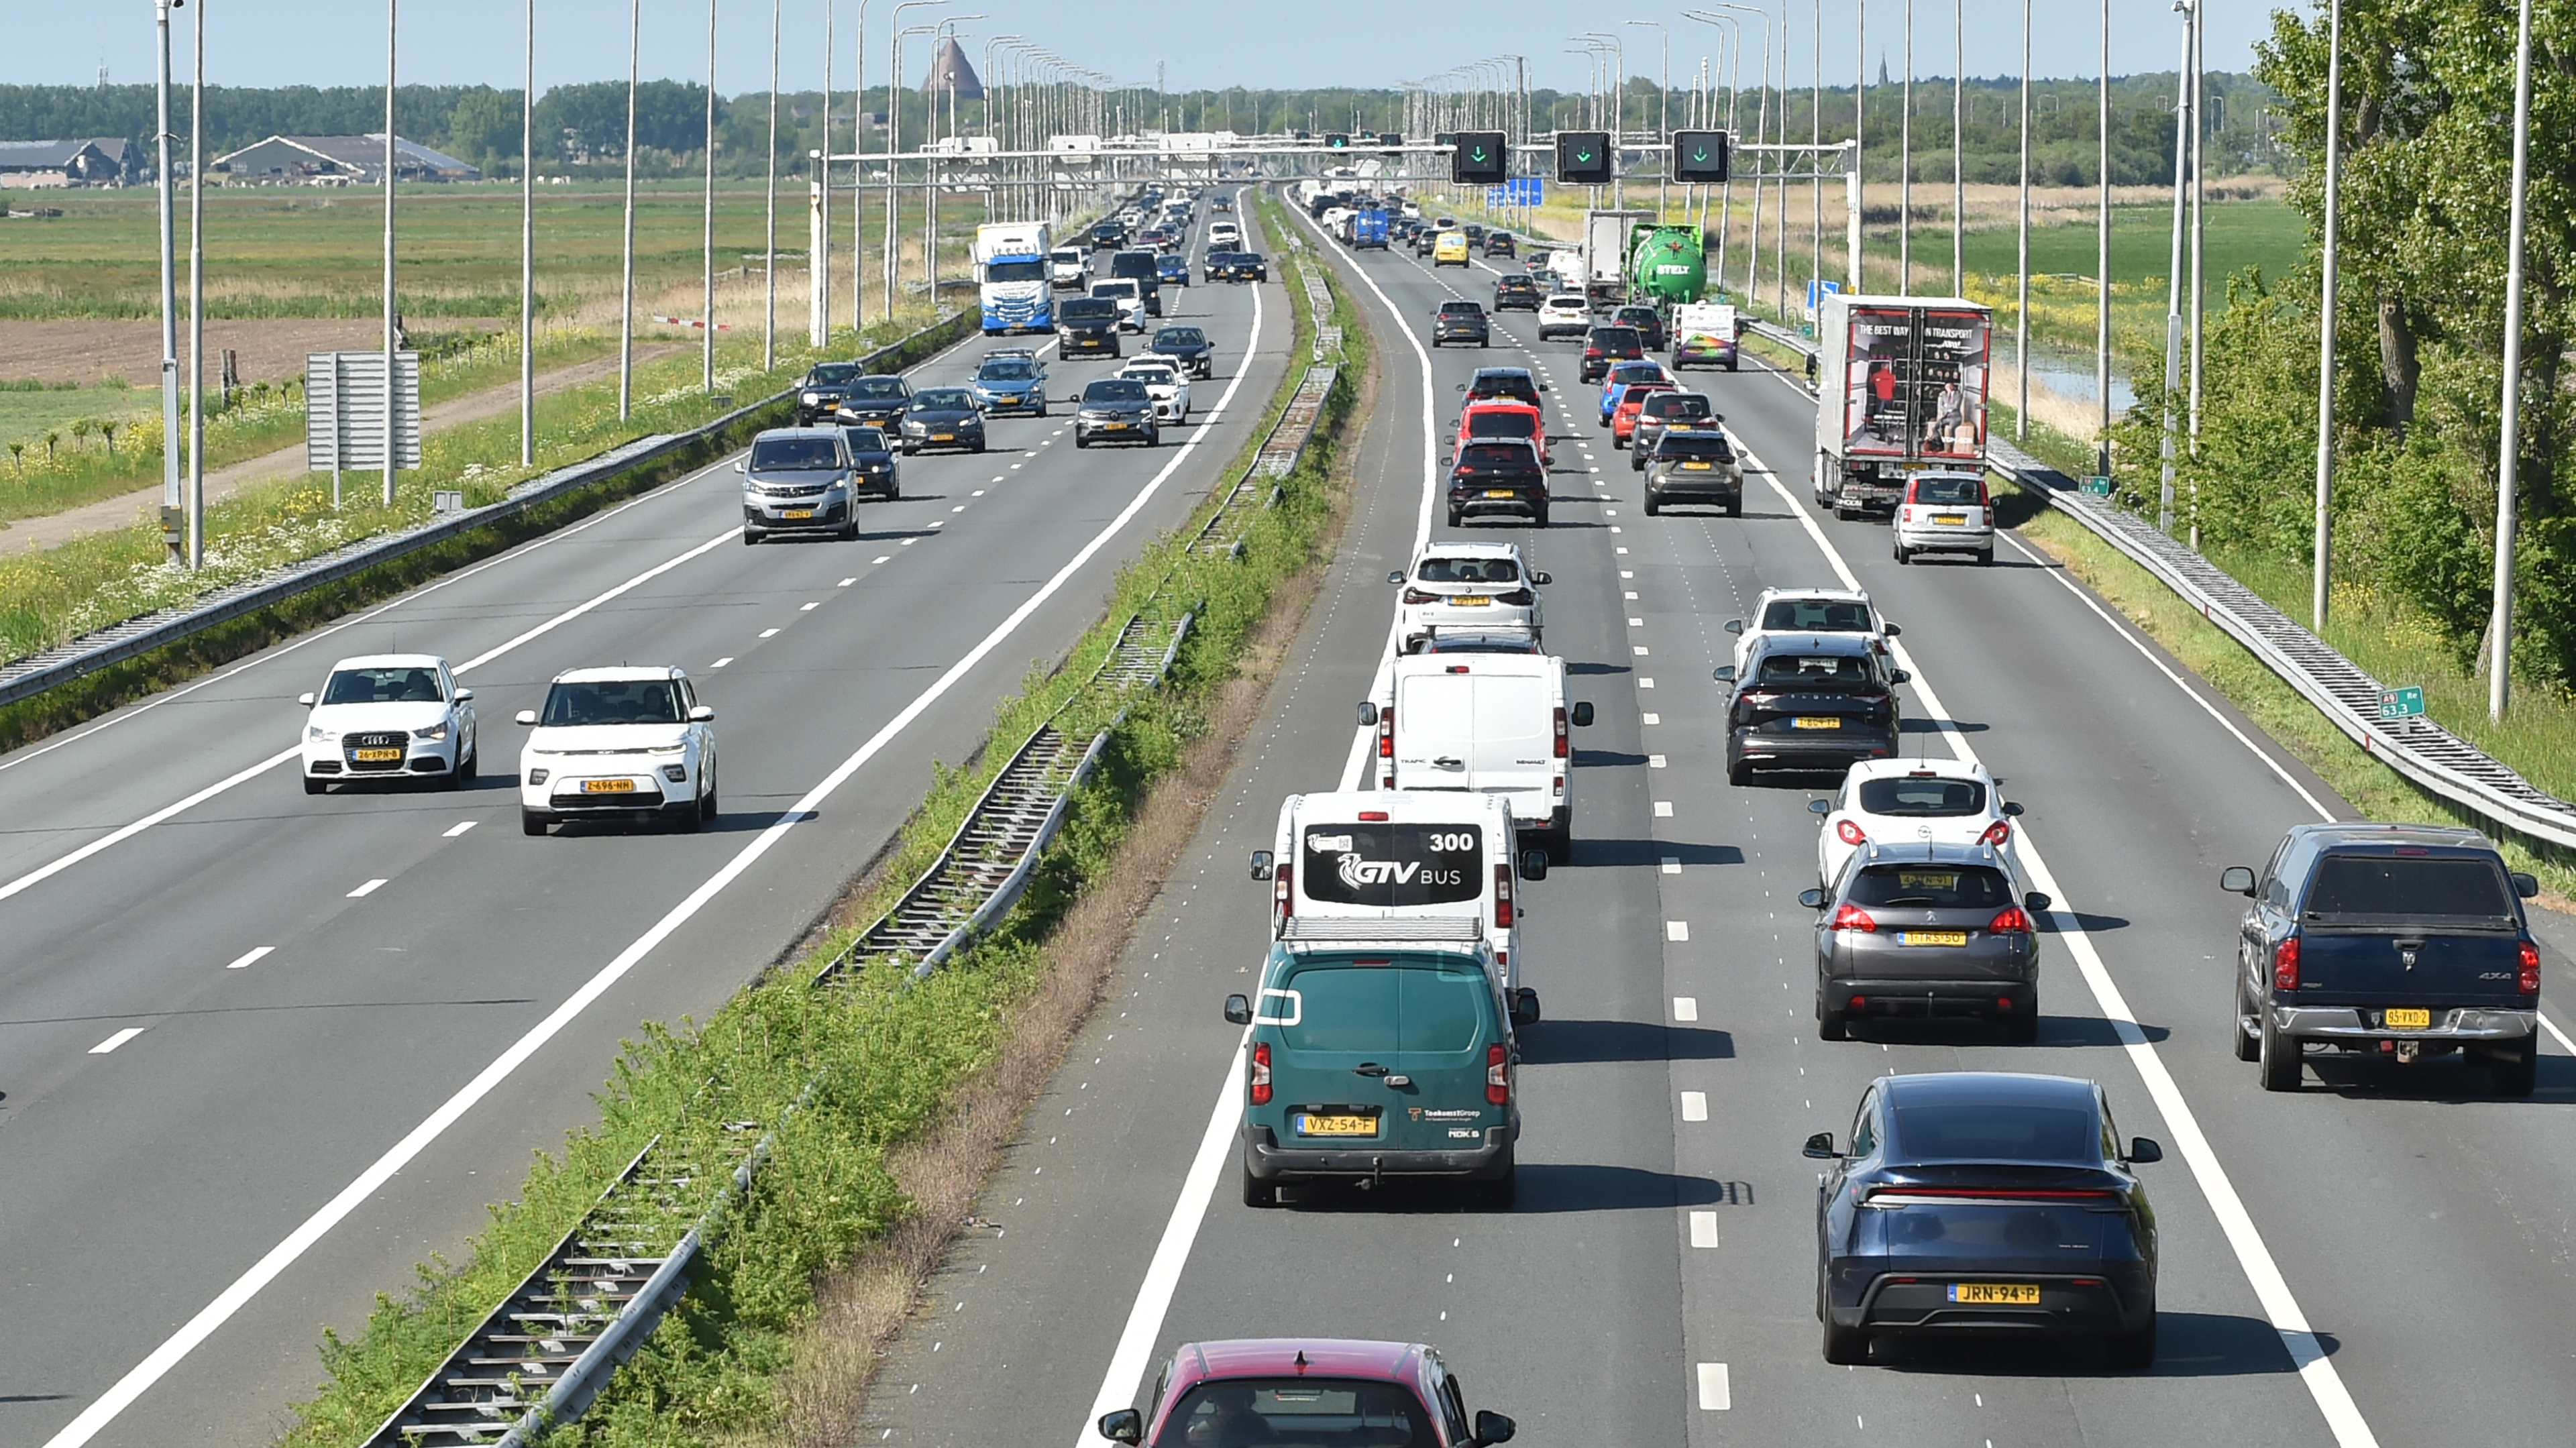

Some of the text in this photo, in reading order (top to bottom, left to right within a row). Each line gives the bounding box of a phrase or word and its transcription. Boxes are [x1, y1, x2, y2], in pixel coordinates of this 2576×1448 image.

[1860, 325, 1873, 335] THE
[1874, 325, 1892, 335] BEST
[1893, 326, 1909, 335] WAY
[1933, 328, 1973, 339] TRANSPORT
[2383, 693, 2396, 703] A9
[2382, 704, 2408, 716] 63,3
[358, 750, 397, 759] 26-XPN-8
[1430, 834, 1474, 852] 300
[1354, 861, 1461, 885] GTV BUS
[2389, 1011, 2426, 1023] 95-VXD-2
[1309, 1119, 1370, 1131] VXZ-54-F
[1963, 1286, 2035, 1300] JRN-94-P
